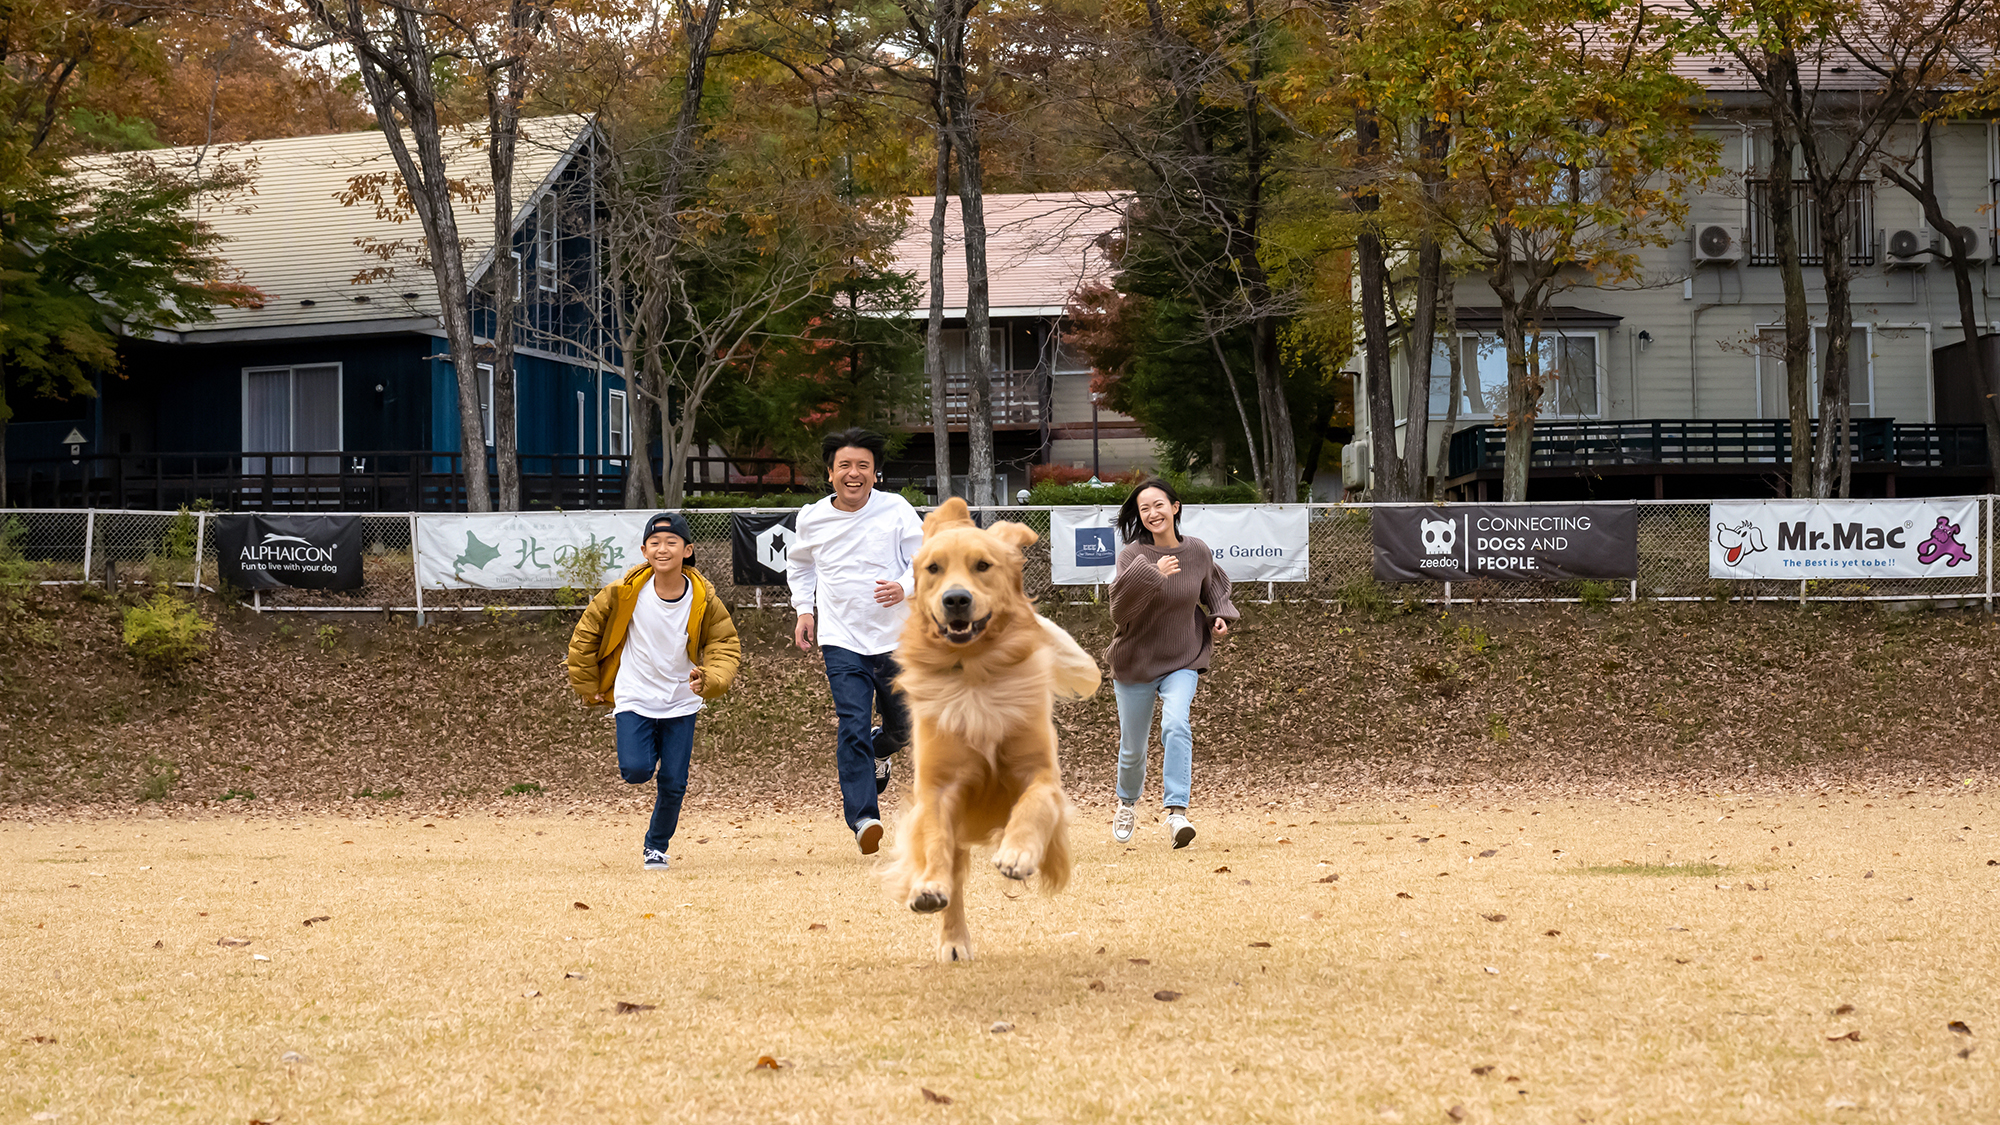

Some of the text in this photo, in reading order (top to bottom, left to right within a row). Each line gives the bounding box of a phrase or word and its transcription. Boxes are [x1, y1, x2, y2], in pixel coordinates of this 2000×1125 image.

[1476, 516, 1591, 531] CONNECTING
[1477, 537, 1568, 550] DOGS AND
[1229, 545, 1283, 558] Garden
[241, 562, 337, 573] Fun to live with your dog
[1477, 556, 1539, 570] PEOPLE.
[1783, 559, 1801, 567] The
[1805, 559, 1827, 567] Best
[1830, 558, 1838, 567] is
[1841, 558, 1858, 568] yet
[1861, 558, 1872, 567] to
